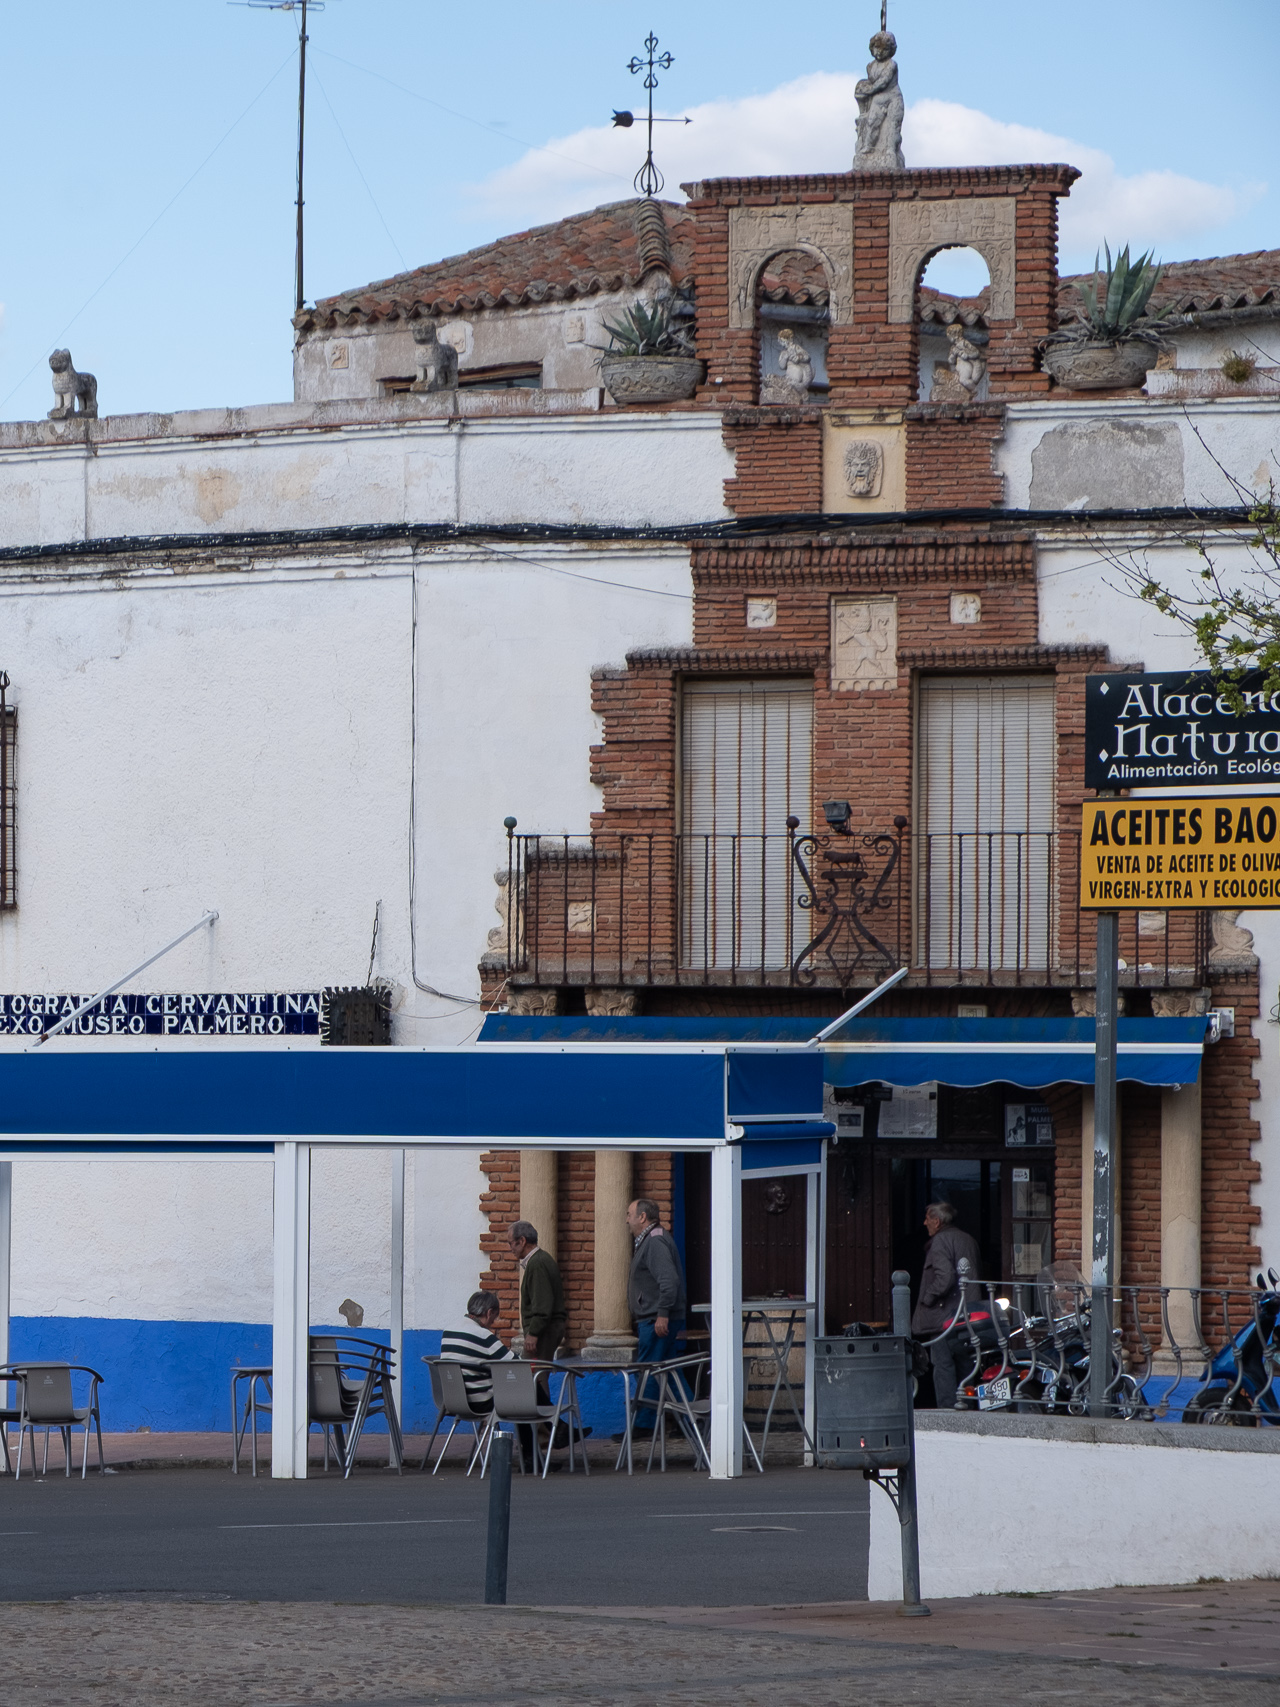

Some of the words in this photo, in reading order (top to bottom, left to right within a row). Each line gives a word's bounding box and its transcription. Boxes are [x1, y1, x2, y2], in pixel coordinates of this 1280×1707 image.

[1107, 760, 1218, 779] Alimentación
[1090, 807, 1202, 846] ACEITES
[1214, 805, 1280, 844] BAO
[1097, 855, 1141, 874] VENTA
[1146, 855, 1163, 874] DE
[1168, 854, 1214, 873] ACEITE
[1219, 853, 1236, 872] DE
[1241, 852, 1280, 872] OLIVA
[1089, 880, 1193, 899] VIRGEN-EXTRA
[1199, 880, 1208, 898] Y
[146, 994, 319, 1014] CERVANTINA
[60, 1015, 145, 1034] MUSEO
[163, 1015, 284, 1034] PALMERO
[984, 1380, 1008, 1394] 350
